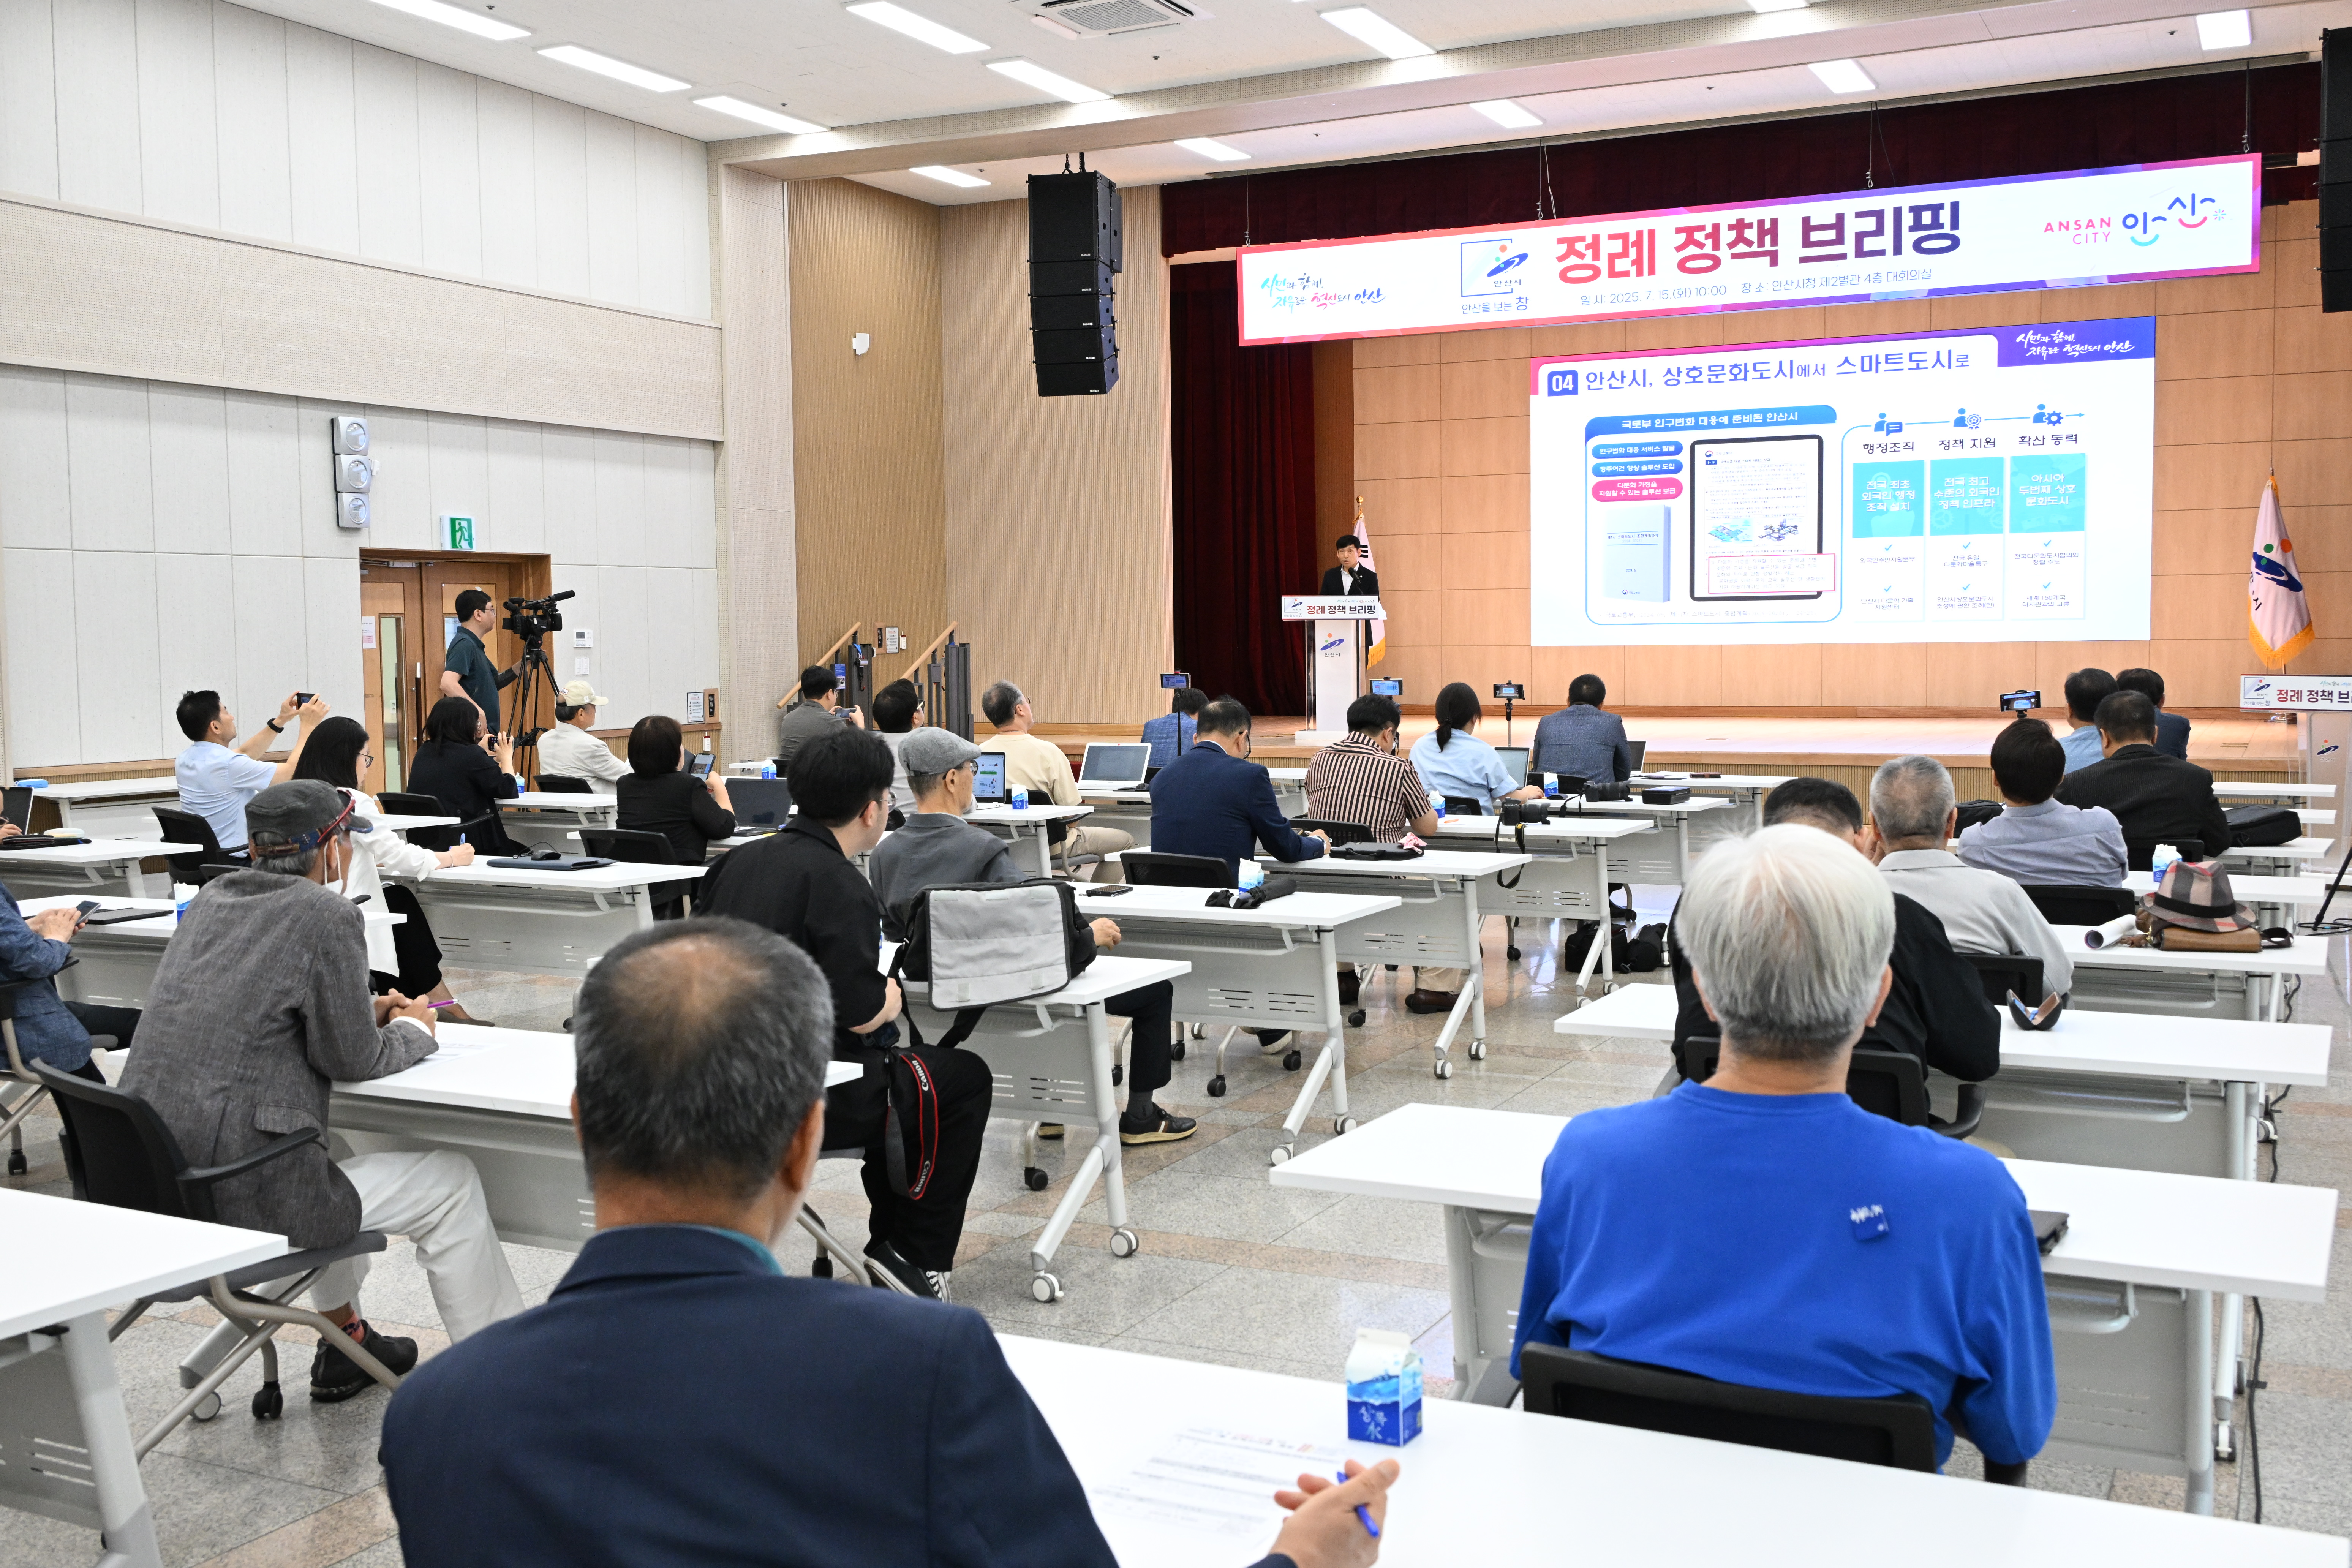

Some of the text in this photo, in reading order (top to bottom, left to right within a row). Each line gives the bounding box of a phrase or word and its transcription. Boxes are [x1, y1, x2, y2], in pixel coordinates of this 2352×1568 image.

[2044, 217, 2111, 233] ANSAN
[1555, 201, 1960, 284] 정례 정책 브리핑
[2072, 231, 2110, 244] CITY
[1261, 273, 1296, 297] 시민과
[1772, 277, 1816, 291] 안산시청
[1819, 274, 1861, 288] 제2별관
[1864, 272, 1882, 284] 4층
[1886, 269, 1932, 283] 대회의실
[1272, 288, 1386, 313] 자유로운 혁신도시 안산
[1610, 292, 1641, 303] 2025.
[1695, 285, 1726, 297] 10:00
[1462, 297, 1529, 314] 안산을 보는 창
[2016, 330, 2051, 348] 시민과
[2026, 340, 2135, 360] 자유로운 혁신도시 안산
[1552, 348, 1969, 392] 04 안산시, 상호문화도시에서 스마트도시로
[1622, 411, 1797, 429] 국토부 인구변화 대응에 준비된 안산시
[1939, 437, 1996, 450] 정책 지원
[2018, 434, 2078, 446] 확산 동력
[1863, 442, 1914, 454] 행정조직
[1866, 480, 1910, 490] 전국 최초
[1944, 476, 1989, 487] 전국 최고
[2031, 474, 2064, 483] 아시아
[1862, 490, 1916, 501] 외국인 행정
[1934, 487, 2000, 498] 수준의 외국인
[2018, 484, 2076, 495] 두번째 상호
[1866, 501, 1910, 512] 조직 설치
[1939, 498, 1995, 509] 정책 인프라
[2026, 495, 2069, 506] 문화도시
[1307, 605, 1375, 614] 정례 정책 브리핑
[2276, 689, 2333, 703] 정례 정책
[912, 1060, 929, 1091] Canon
[914, 1160, 930, 1192] Canon
